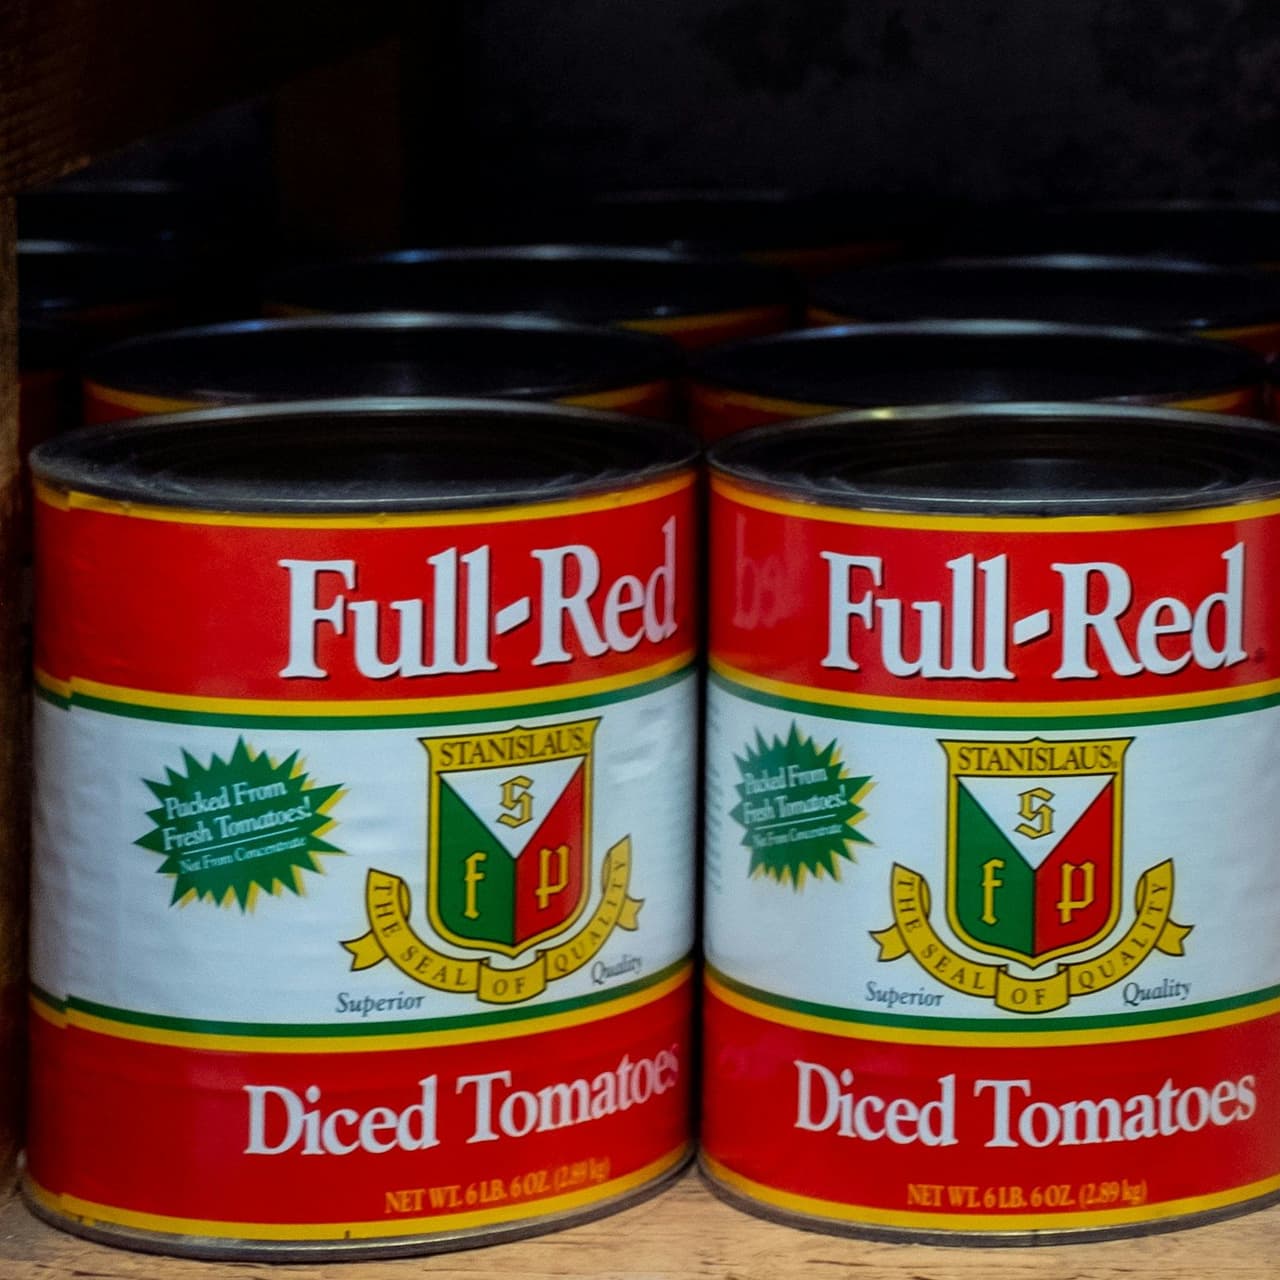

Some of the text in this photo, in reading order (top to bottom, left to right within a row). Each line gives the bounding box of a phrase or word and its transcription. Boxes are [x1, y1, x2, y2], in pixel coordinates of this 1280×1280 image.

[279, 516, 678, 680] Full-Red
[821, 542, 1247, 682] Full-Red
[439, 728, 585, 767] STANISLAUS
[958, 745, 1113, 771] STANISLAUS
[164, 797, 313, 849] Fresh Tomatoes!
[166, 779, 287, 816] Packed From
[335, 955, 644, 1016] Superior Quality
[866, 979, 1192, 1009] Superior Quality
[243, 1075, 442, 1157] Diced
[795, 1058, 1257, 1149] Diced Tomatoes
[907, 1181, 1147, 1209] NET WT. 6 LB. 6 OZ. (2.89 kg)
